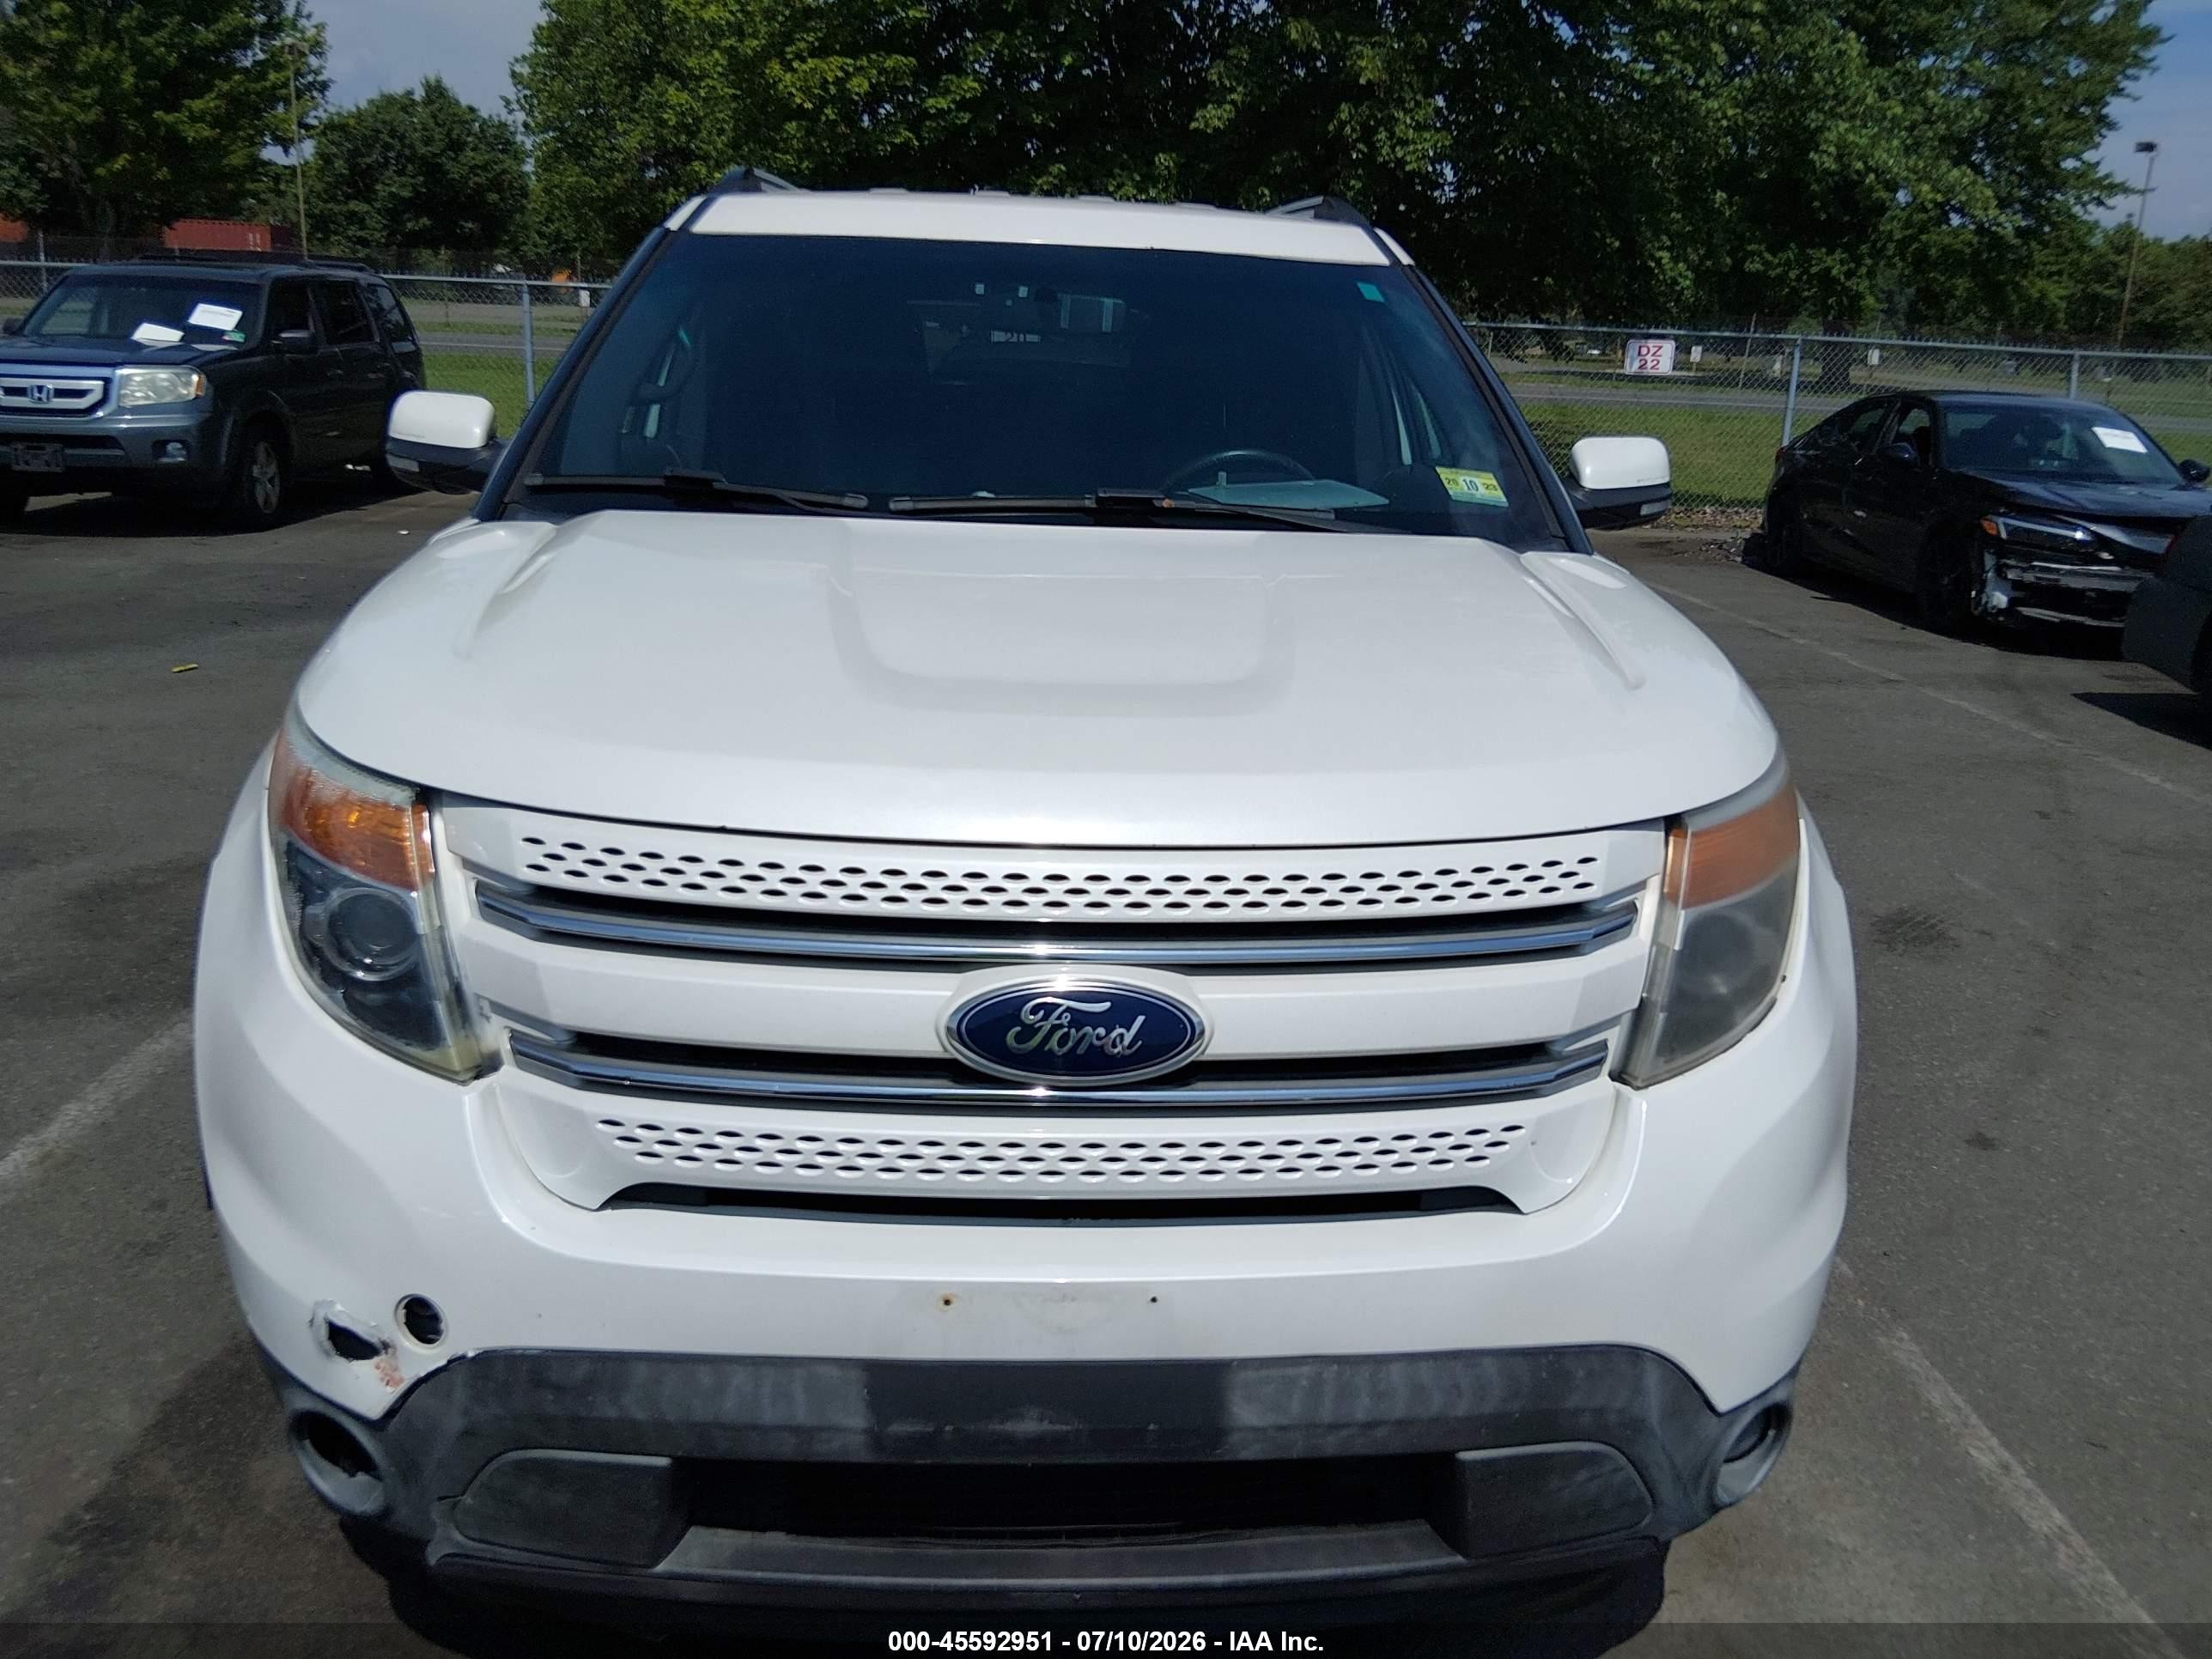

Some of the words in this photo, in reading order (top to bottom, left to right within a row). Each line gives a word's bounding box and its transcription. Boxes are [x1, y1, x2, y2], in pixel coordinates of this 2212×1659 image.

[1638, 345, 1663, 357] DZ
[1638, 358, 1661, 370] 22
[1462, 478, 1479, 492] 10
[1006, 996, 1146, 1056] Ford
